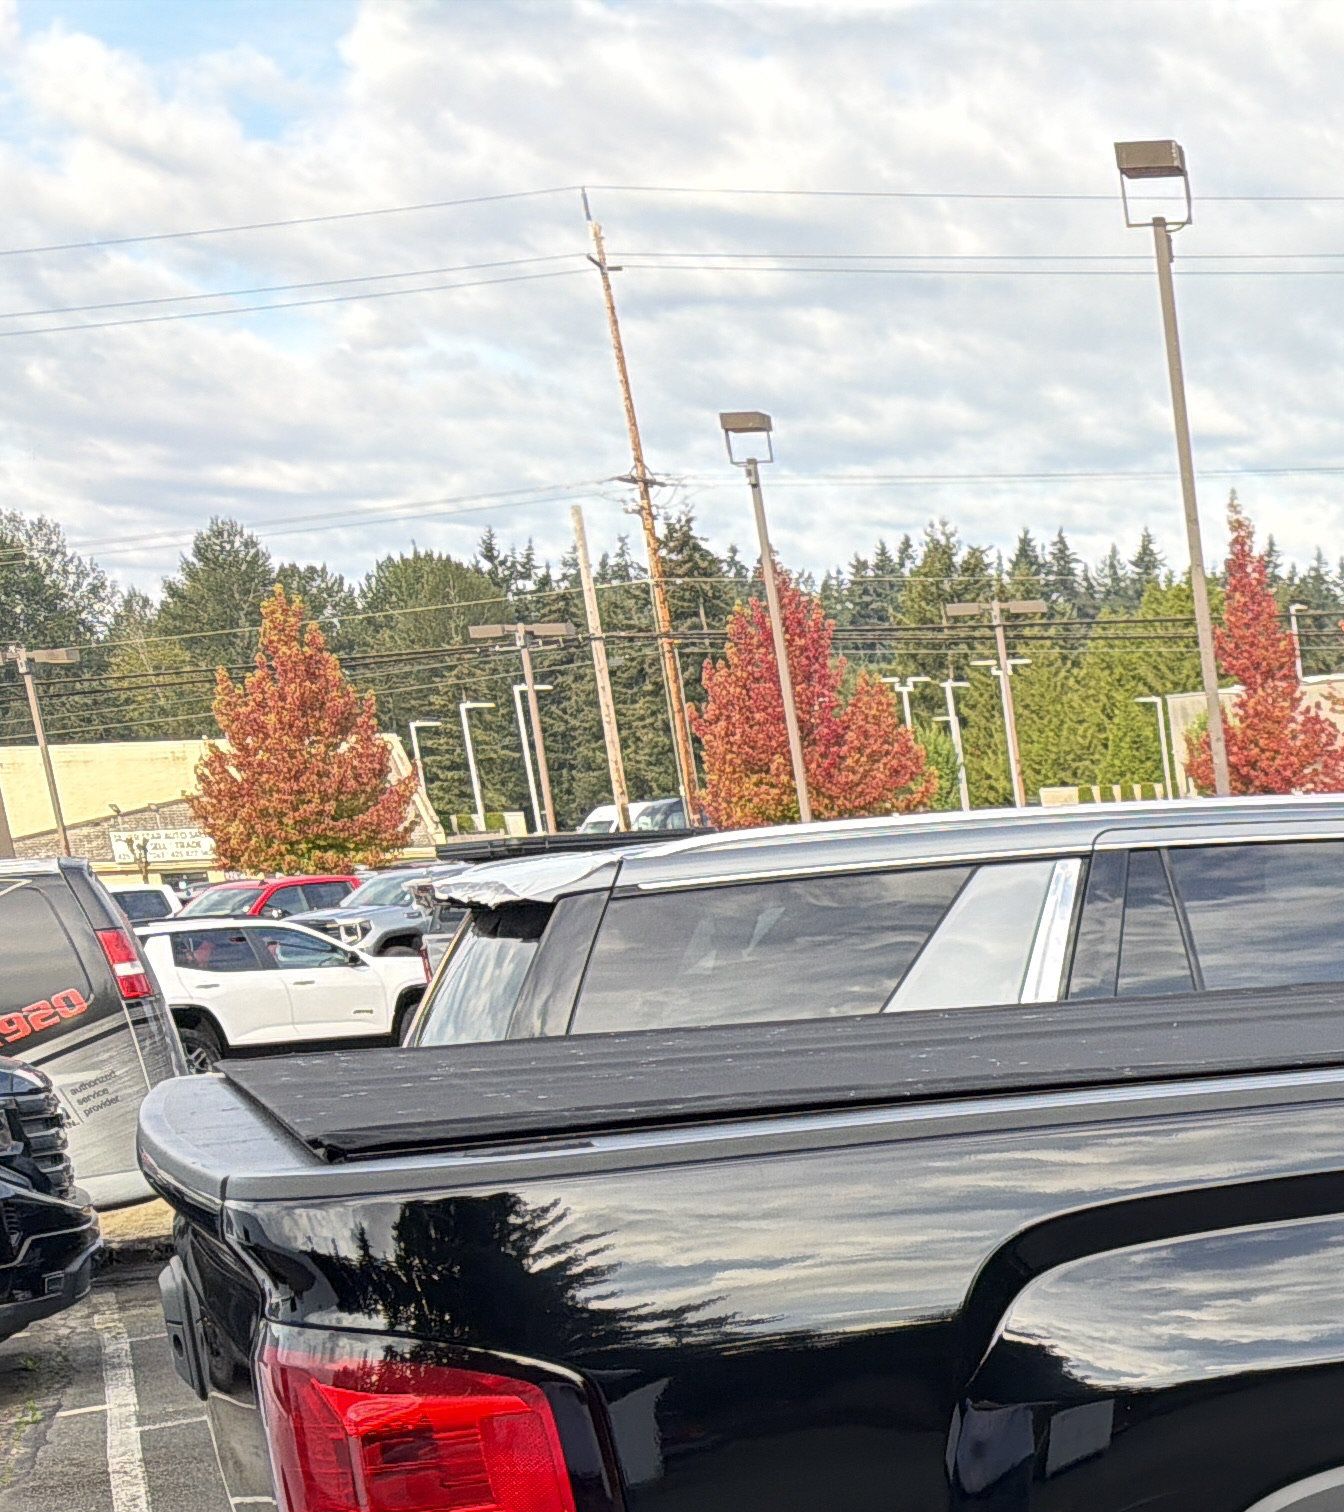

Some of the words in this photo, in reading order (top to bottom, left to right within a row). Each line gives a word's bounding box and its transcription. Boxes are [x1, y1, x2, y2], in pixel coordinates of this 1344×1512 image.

[69, 1069, 117, 1095] authorized
[77, 1087, 110, 1106] service
[83, 1095, 121, 1117] provider
